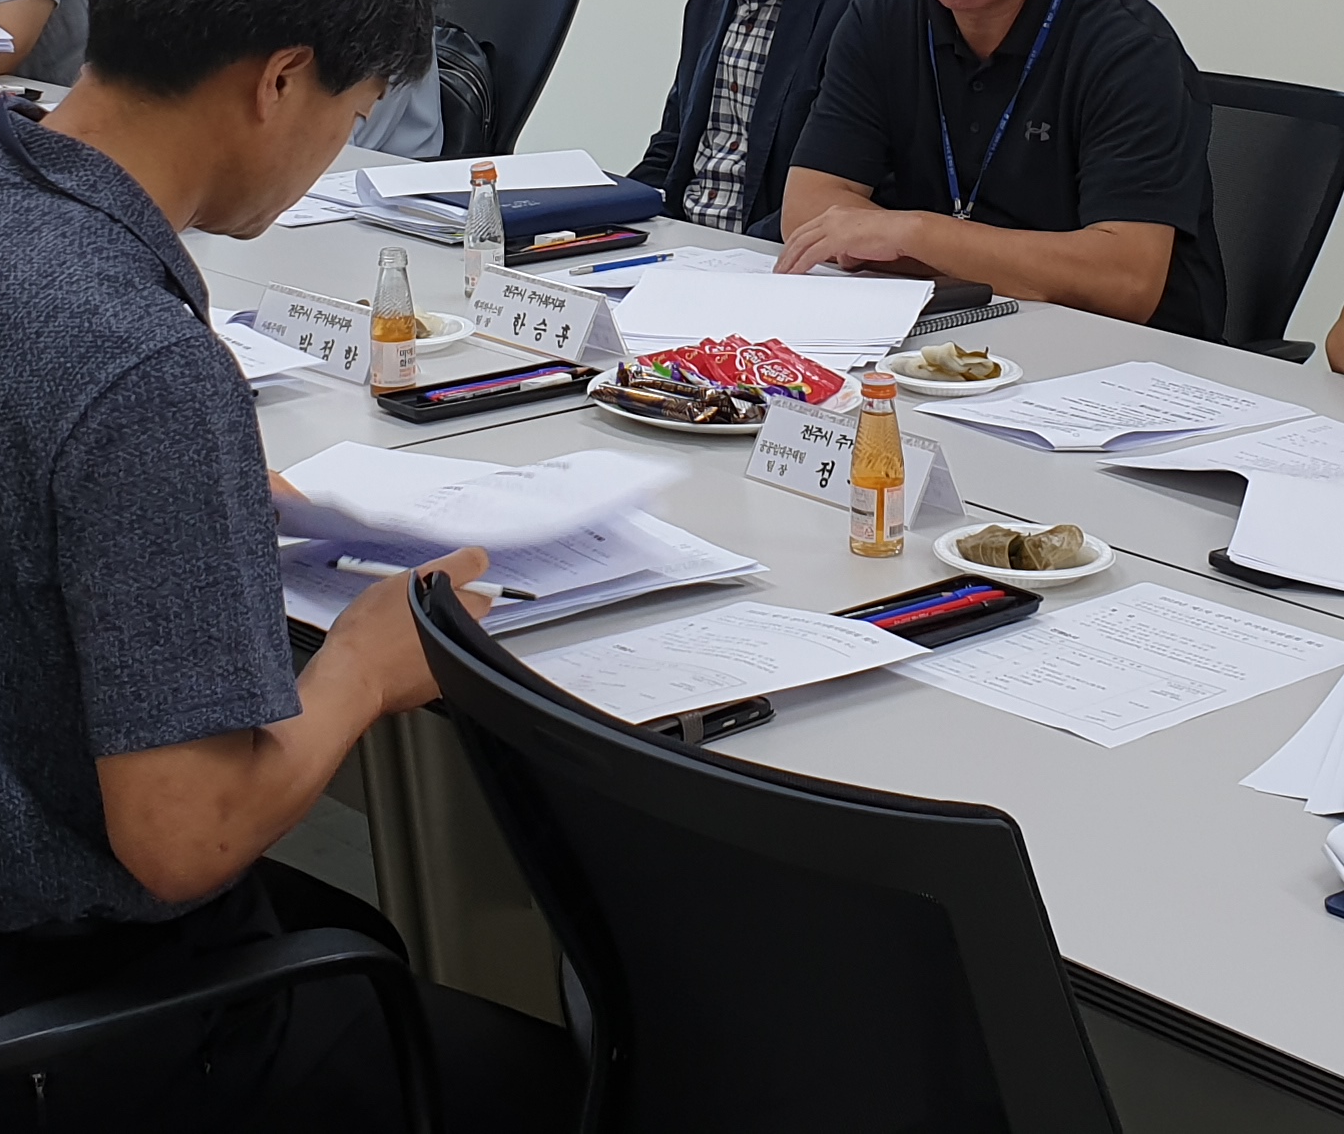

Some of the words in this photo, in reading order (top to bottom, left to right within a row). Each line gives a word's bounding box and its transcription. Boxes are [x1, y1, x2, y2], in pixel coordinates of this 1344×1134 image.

[503, 284, 527, 302] 전주시
[527, 290, 566, 313] 주거복지과
[287, 303, 313, 322] 전주시
[313, 310, 353, 333] 주거복지과
[800, 424, 834, 448] 전주시
[815, 460, 836, 489] 정
